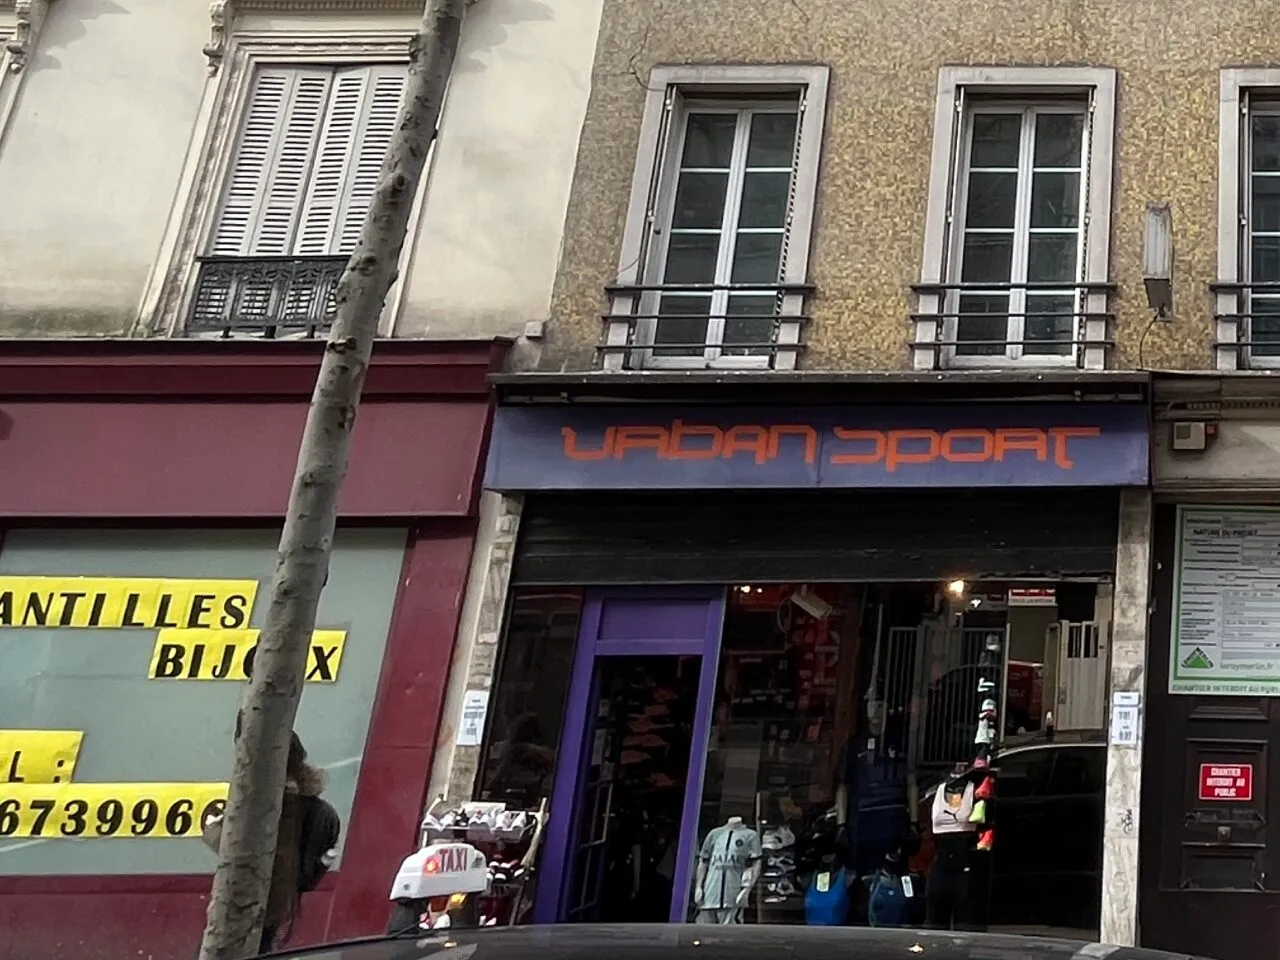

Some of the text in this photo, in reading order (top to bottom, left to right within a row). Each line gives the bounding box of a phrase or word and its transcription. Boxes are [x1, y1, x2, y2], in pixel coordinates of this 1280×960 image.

[560, 418, 1100, 472] URBAN SPORT
[440, 848, 468, 872] TAXI
